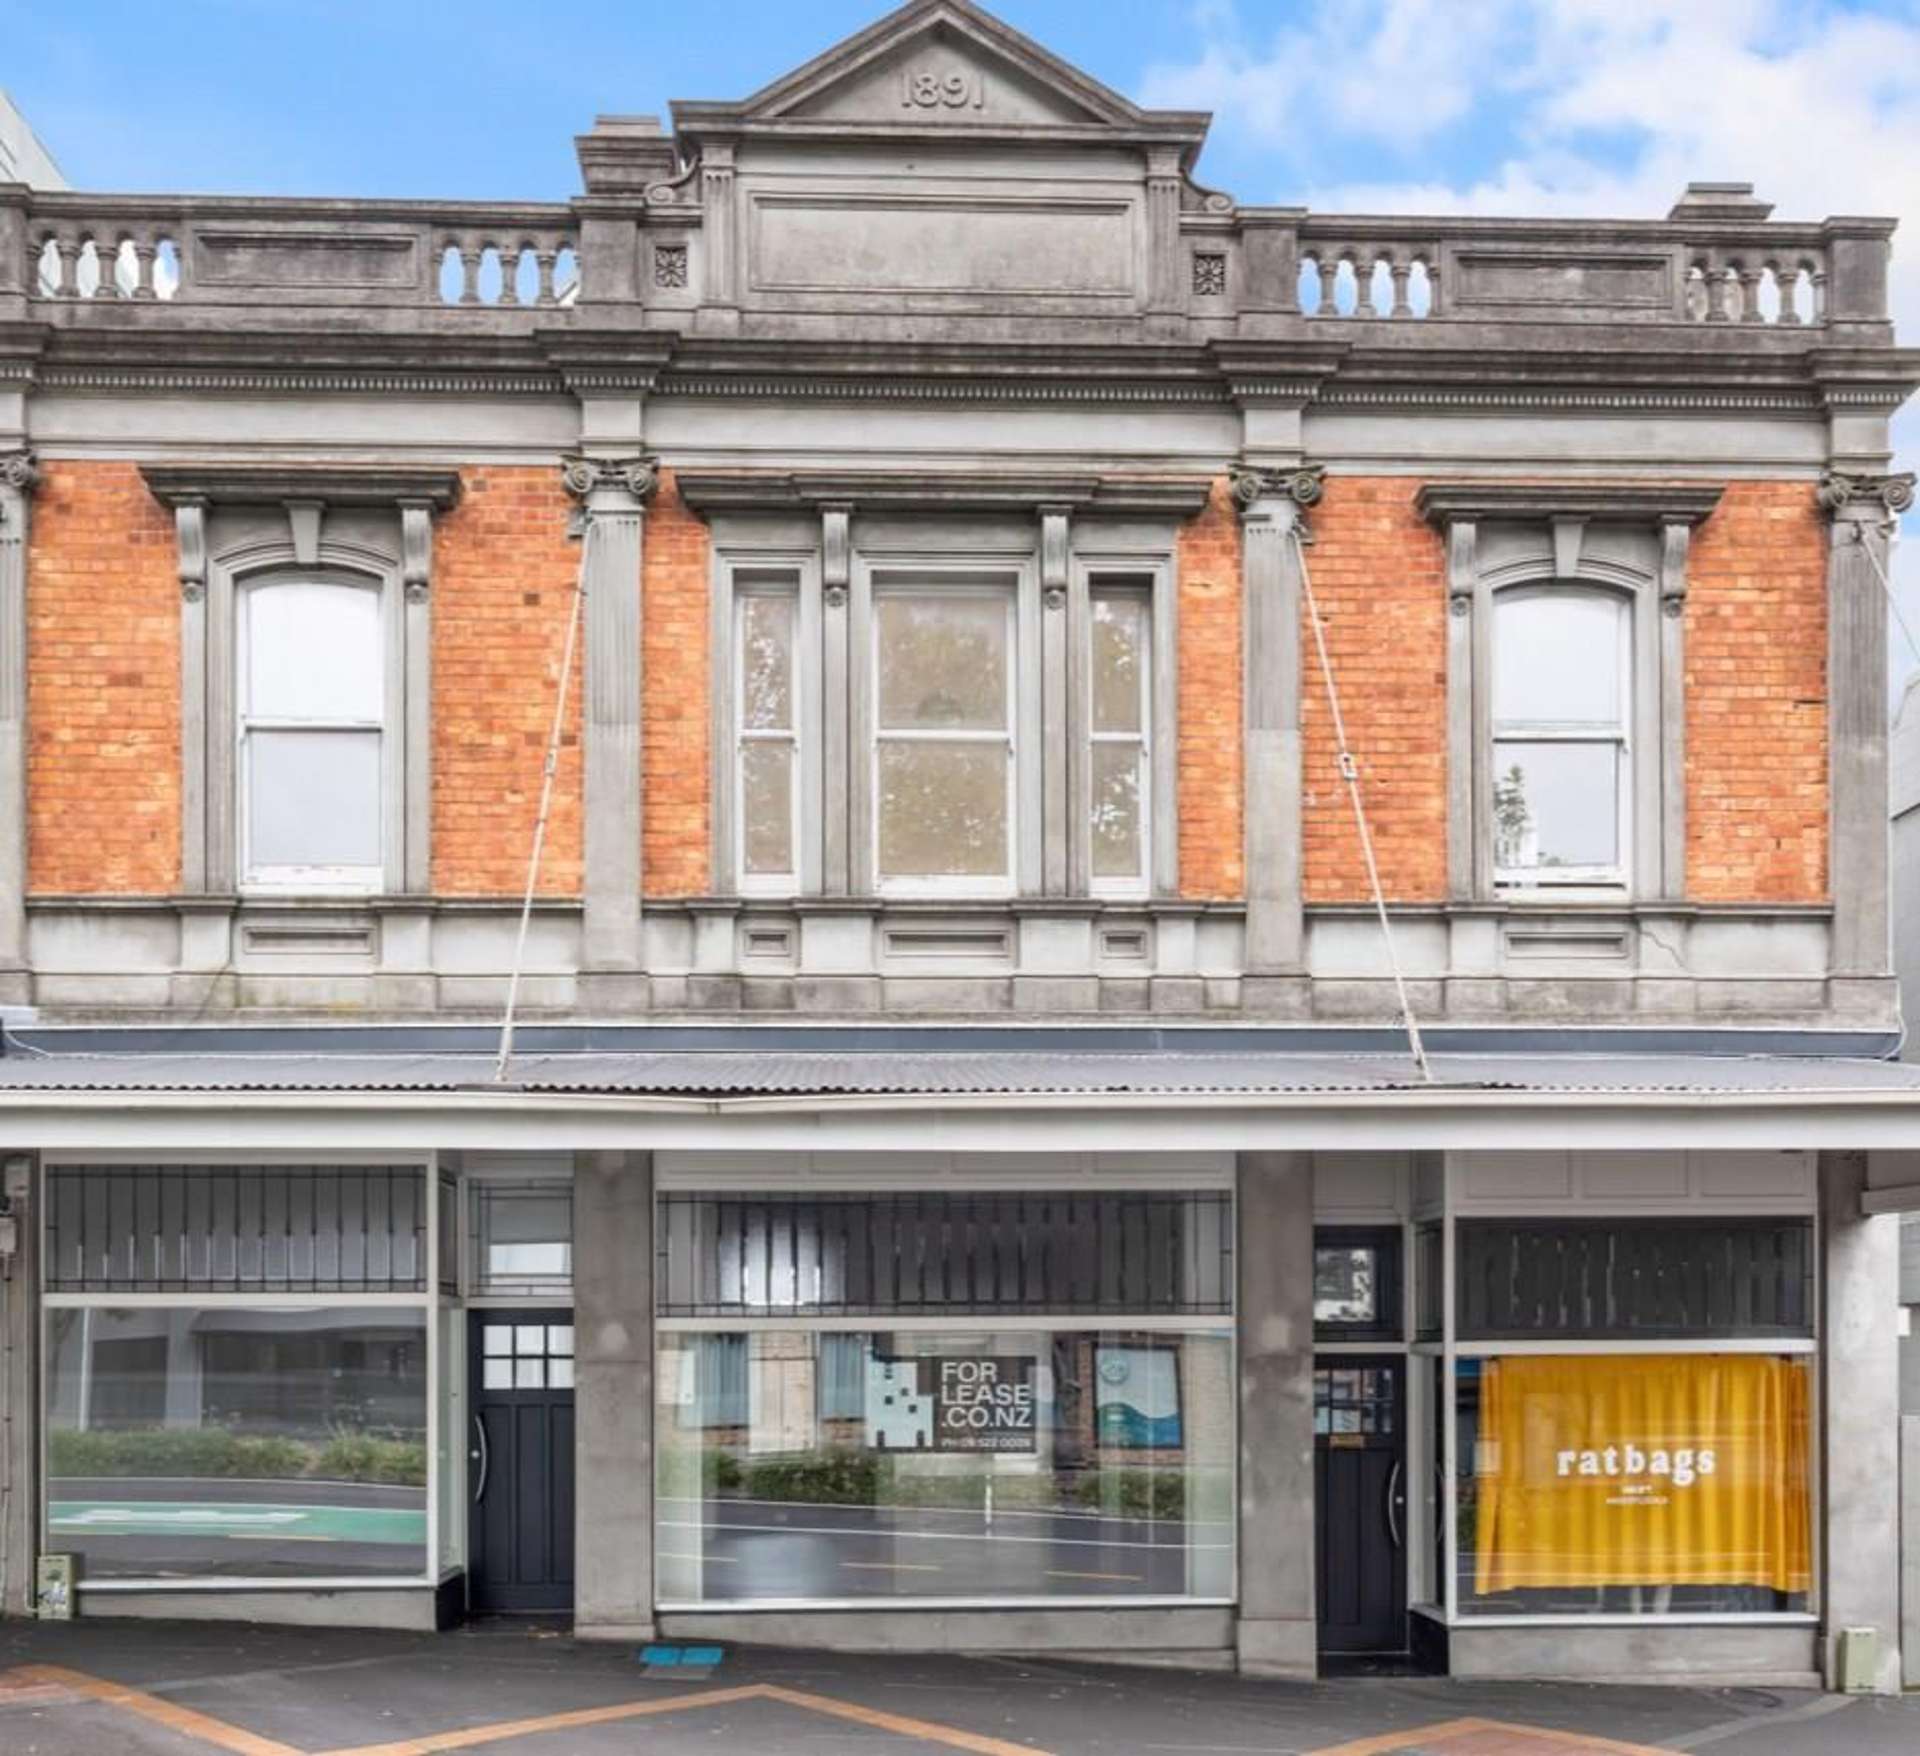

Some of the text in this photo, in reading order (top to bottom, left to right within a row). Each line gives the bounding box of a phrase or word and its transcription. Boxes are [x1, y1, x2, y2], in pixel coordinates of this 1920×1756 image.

[901, 72, 984, 109] 1891
[941, 1361, 998, 1383] FOR
[941, 1384, 1032, 1405] LEASE
[941, 1406, 1033, 1428] .CO.NZ
[1557, 1443, 1716, 1486] ratbags
